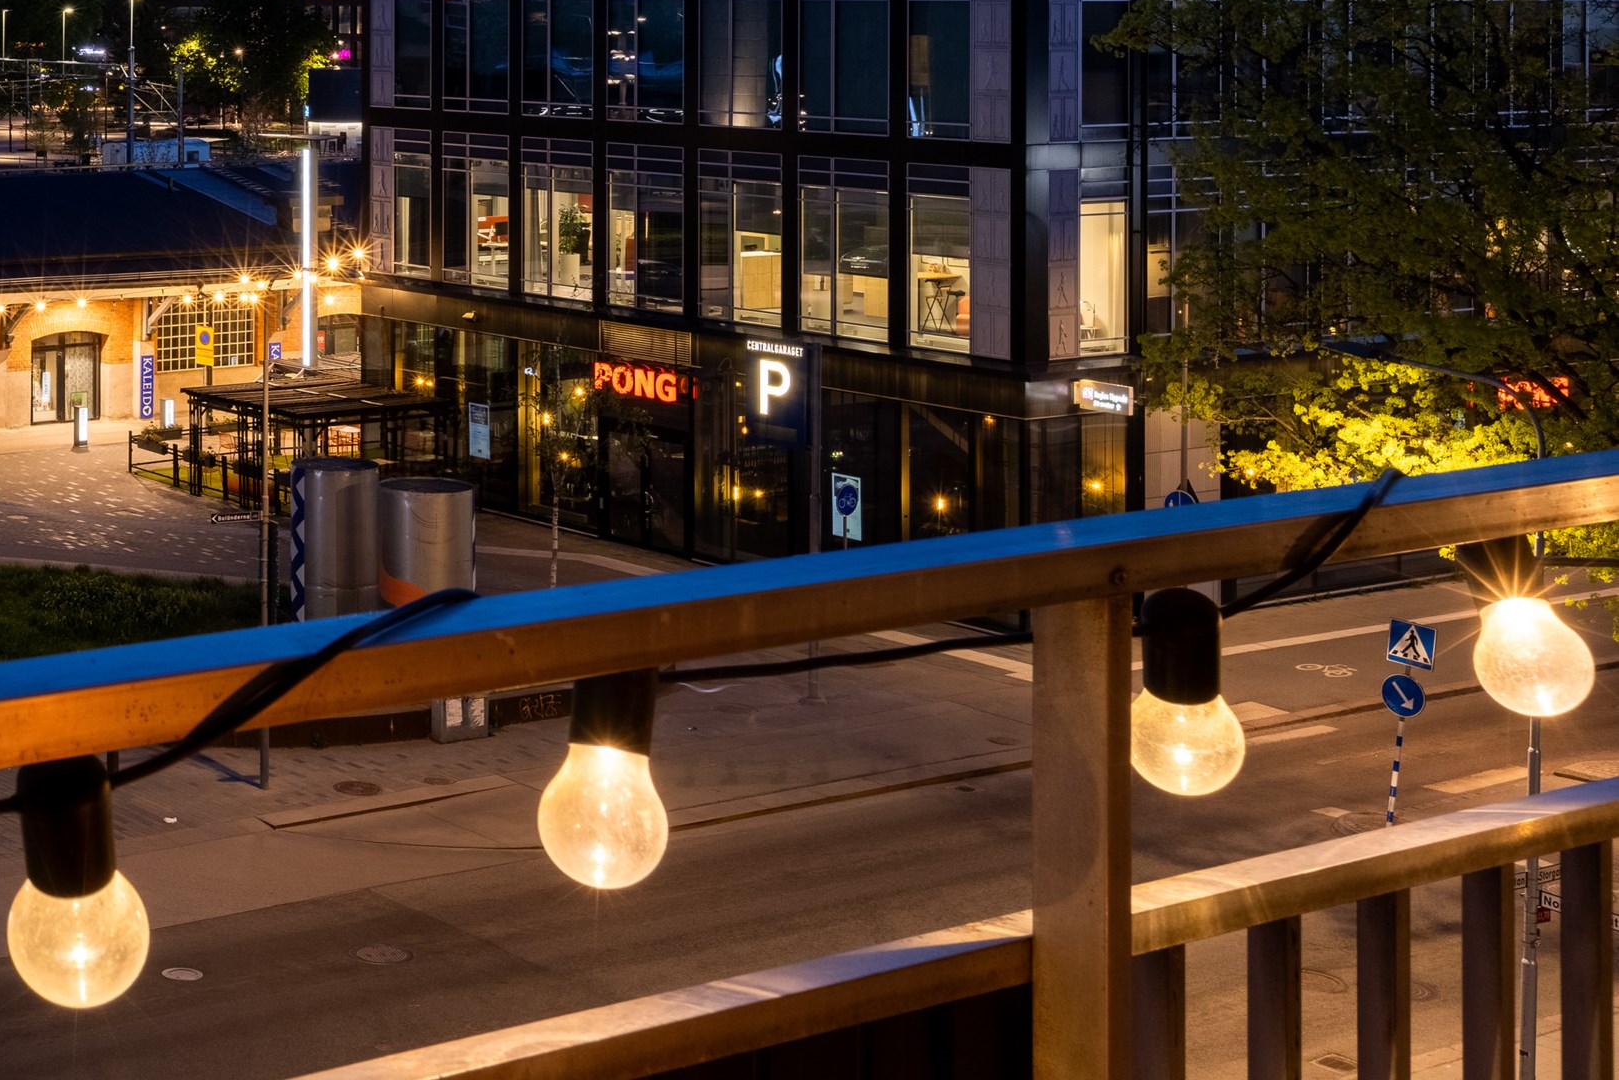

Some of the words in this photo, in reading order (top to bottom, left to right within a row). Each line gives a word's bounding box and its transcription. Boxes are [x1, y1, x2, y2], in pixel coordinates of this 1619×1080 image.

[746, 340, 804, 357] CENTRALGARAGET
[142, 357, 153, 417] KALEIDO
[594, 361, 677, 403] PONG
[759, 359, 791, 415] P
